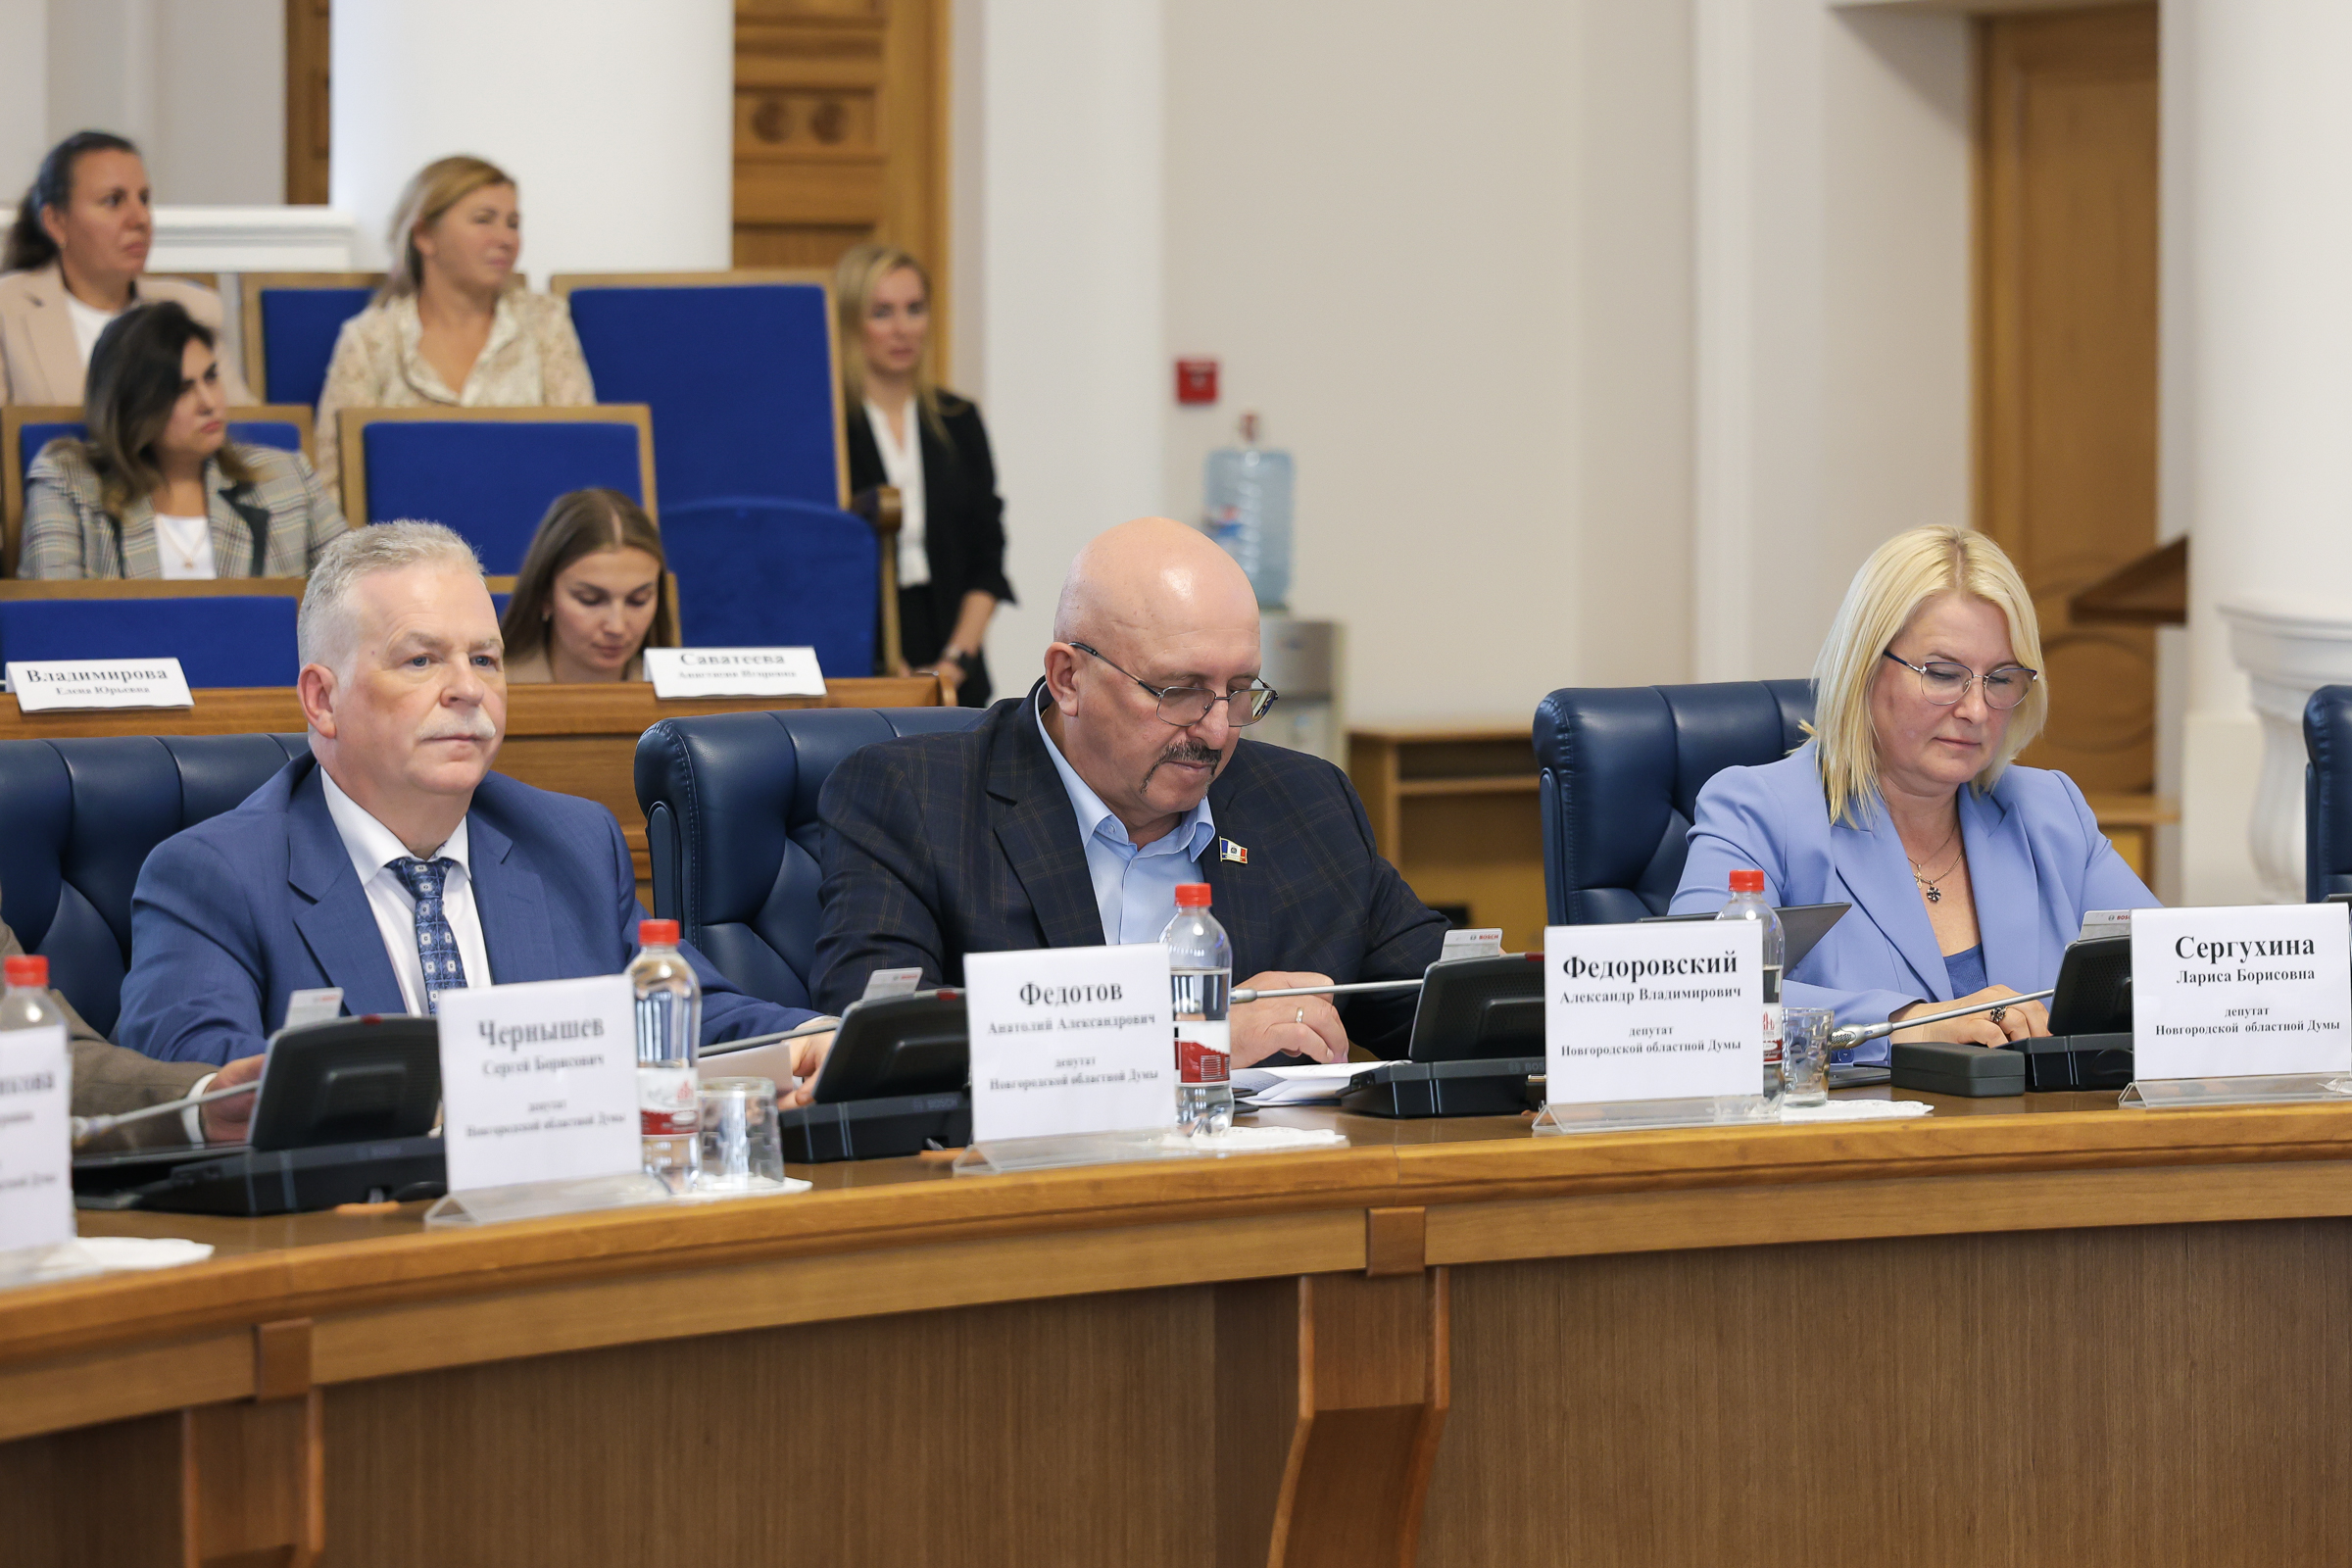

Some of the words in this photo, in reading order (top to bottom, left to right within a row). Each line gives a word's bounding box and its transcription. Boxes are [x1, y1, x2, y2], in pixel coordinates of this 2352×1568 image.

[680, 653, 785, 665] Саватеева
[26, 669, 168, 684] Владимирова
[56, 687, 92, 696] Елена
[94, 686, 150, 696] Юрьевна
[2175, 936, 2315, 964] Сергухина
[1562, 950, 1738, 983] Федоровский
[2176, 970, 2231, 987] Лариса
[2236, 968, 2315, 984] Борисовна
[1019, 981, 1123, 1006] Федотов
[1560, 991, 1635, 1005] Александр
[1640, 987, 1740, 1003] Владимирович
[2225, 1006, 2270, 1019] депутат
[988, 1017, 1053, 1035] Анатолий
[1056, 1013, 1156, 1031] Александрович
[1629, 1025, 1674, 1038] депутат
[2156, 1022, 2239, 1038] Новгородской
[2244, 1021, 2304, 1033] областной
[2307, 1019, 2340, 1033] Думы
[478, 1017, 605, 1052] Чернышев
[1561, 1044, 1643, 1058] Новгородской
[1645, 1041, 1705, 1054] областной
[1707, 1039, 1741, 1054] Думы
[482, 1058, 529, 1077] Сергей
[534, 1054, 605, 1073] Борисович
[1054, 1056, 1096, 1069] депутат
[1127, 1068, 1158, 1083] Думы
